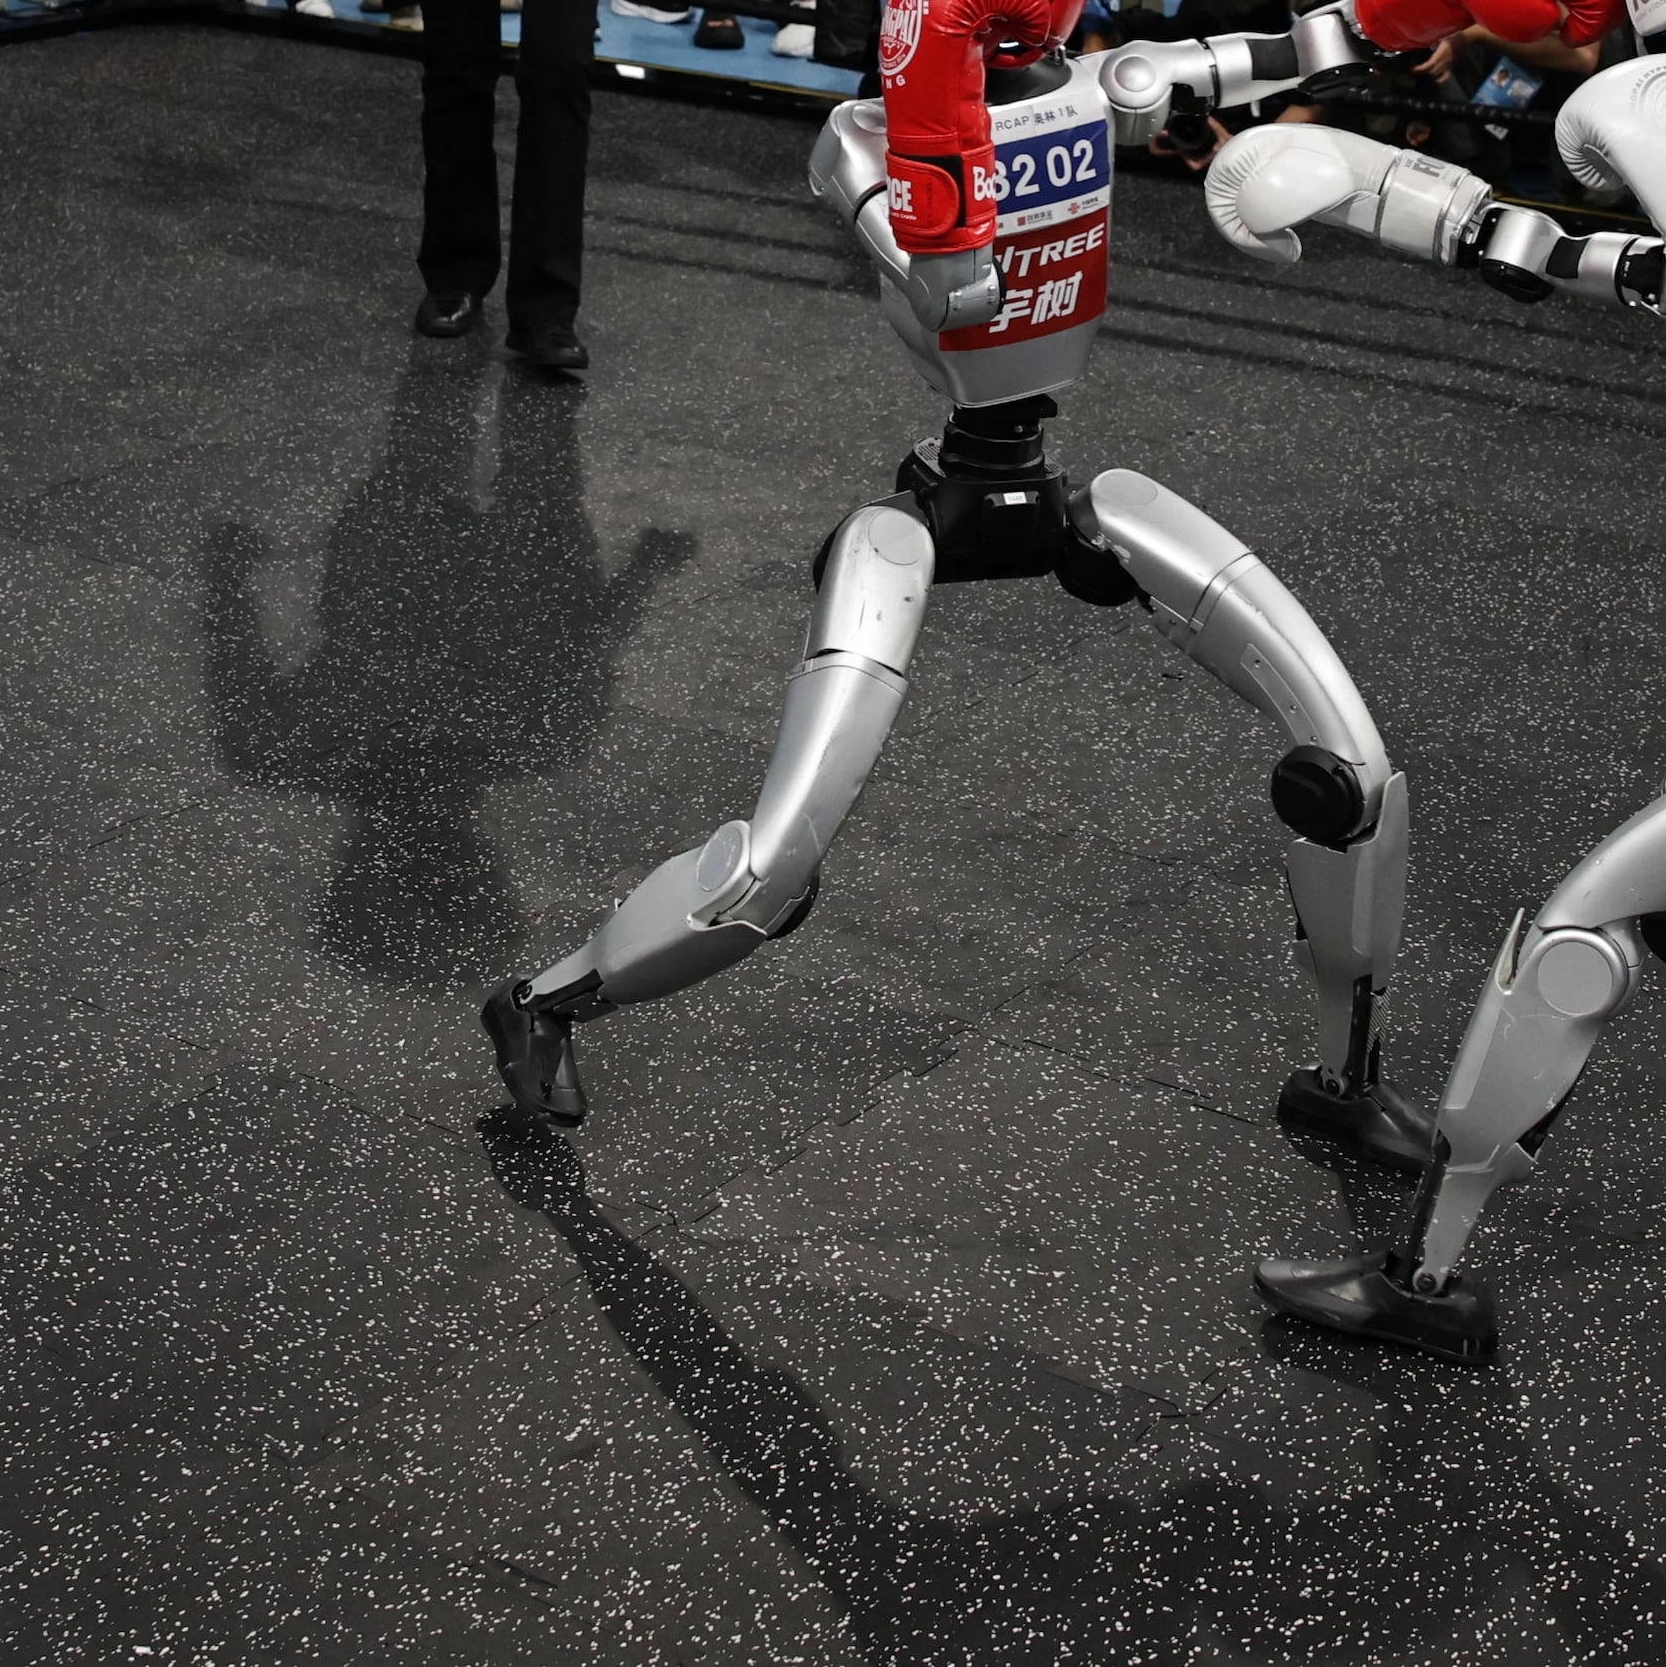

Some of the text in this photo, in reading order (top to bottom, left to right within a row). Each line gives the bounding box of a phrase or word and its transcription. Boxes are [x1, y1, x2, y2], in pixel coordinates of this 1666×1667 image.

[994, 116, 1030, 132] RCAP
[995, 222, 1106, 278] ITREE
[988, 270, 1083, 334] 宇树
